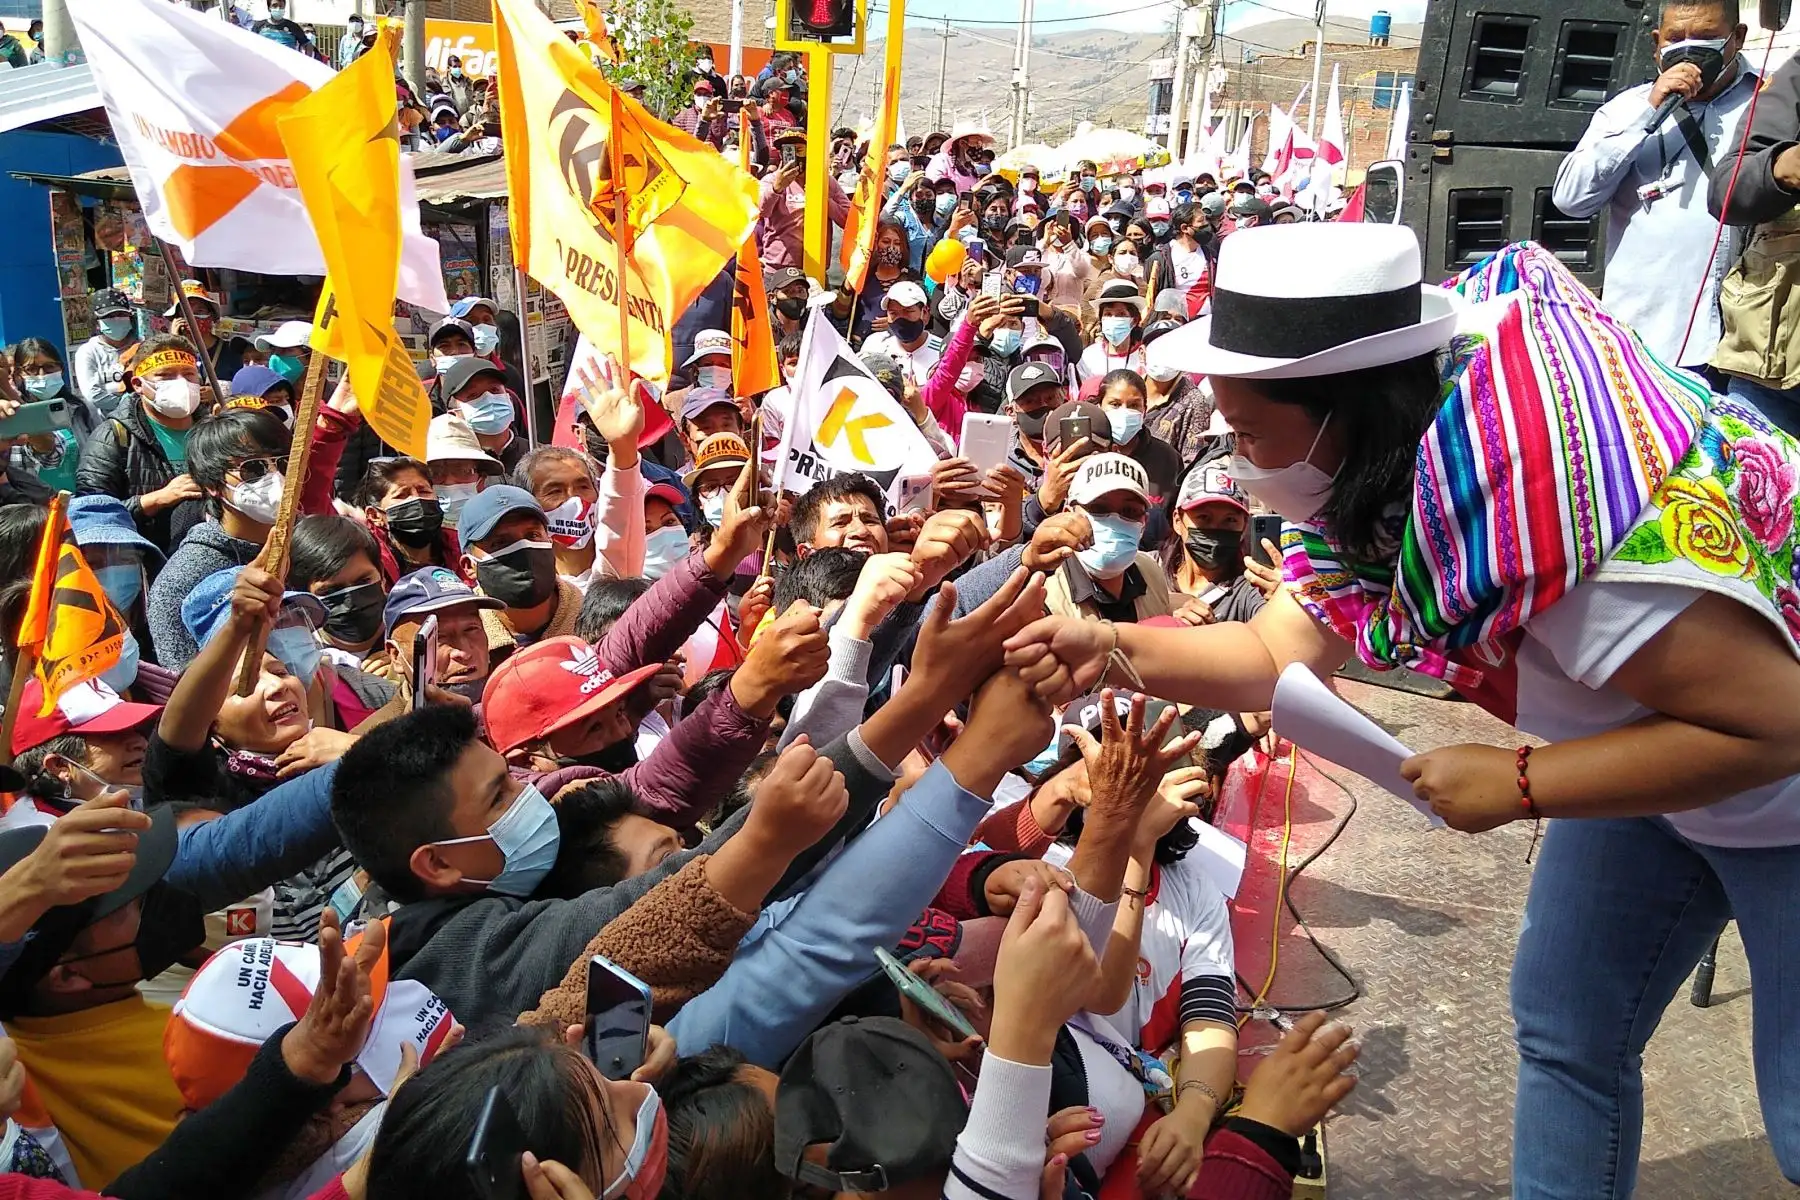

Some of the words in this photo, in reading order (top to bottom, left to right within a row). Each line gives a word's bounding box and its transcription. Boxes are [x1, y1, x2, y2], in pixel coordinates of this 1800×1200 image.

[565, 246, 666, 338] PRESIENTA
[1086, 460, 1145, 489] POLICIA
[237, 966, 253, 988] UN
[248, 967, 270, 1011] HACIA
[414, 1006, 430, 1023] UN
[415, 1013, 440, 1043] HACIA
